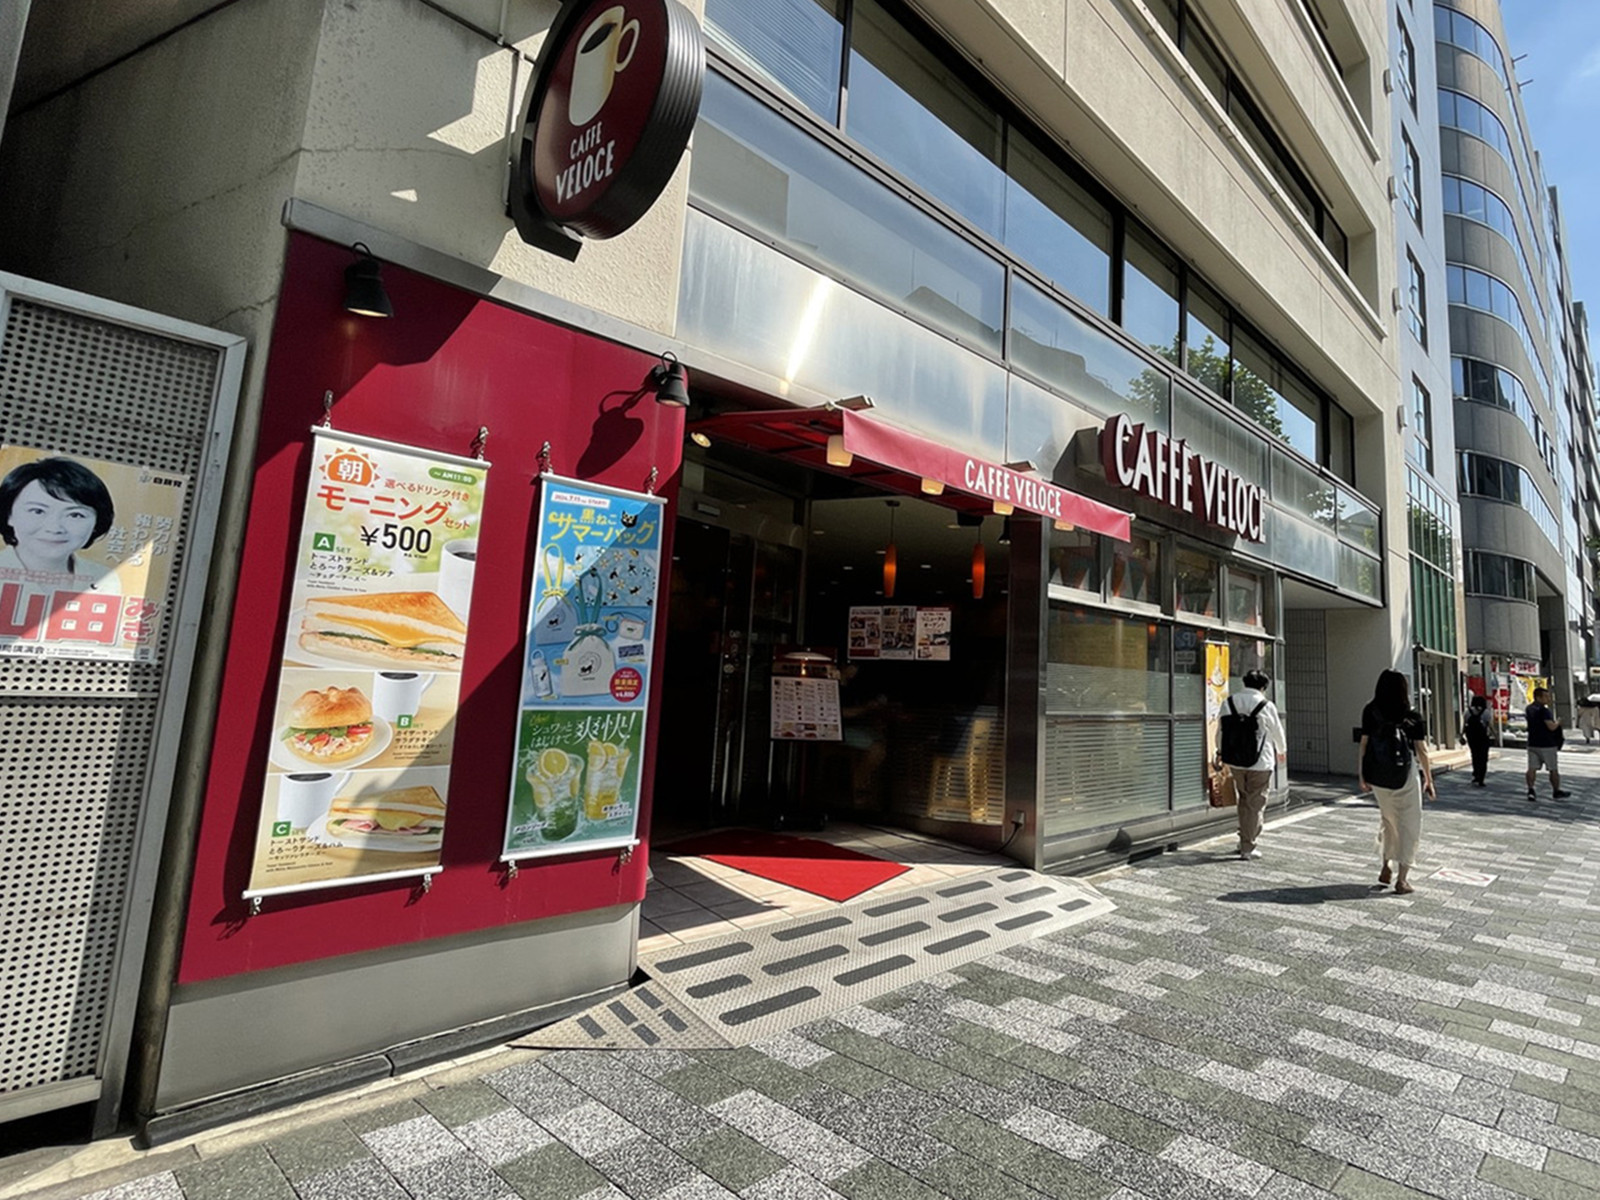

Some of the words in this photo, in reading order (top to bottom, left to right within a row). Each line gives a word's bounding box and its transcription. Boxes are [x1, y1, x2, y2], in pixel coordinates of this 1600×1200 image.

[555, 139, 616, 204] VELOCE
[337, 458, 364, 482] 朝
[384, 478, 470, 502] 選べるドリンク付き
[1014, 475, 1062, 517] VELOCE
[1199, 454, 1267, 544] VELOCE
[316, 484, 452, 525] モーニング
[443, 517, 470, 531] セット
[580, 508, 617, 526] 黒ねこ
[317, 536, 331, 548] A
[360, 523, 432, 553] ¥500
[547, 511, 658, 545] サマーバッグ
[311, 552, 368, 565] トーストサンド
[122, 596, 160, 643] みき
[532, 721, 573, 736] シュワッと
